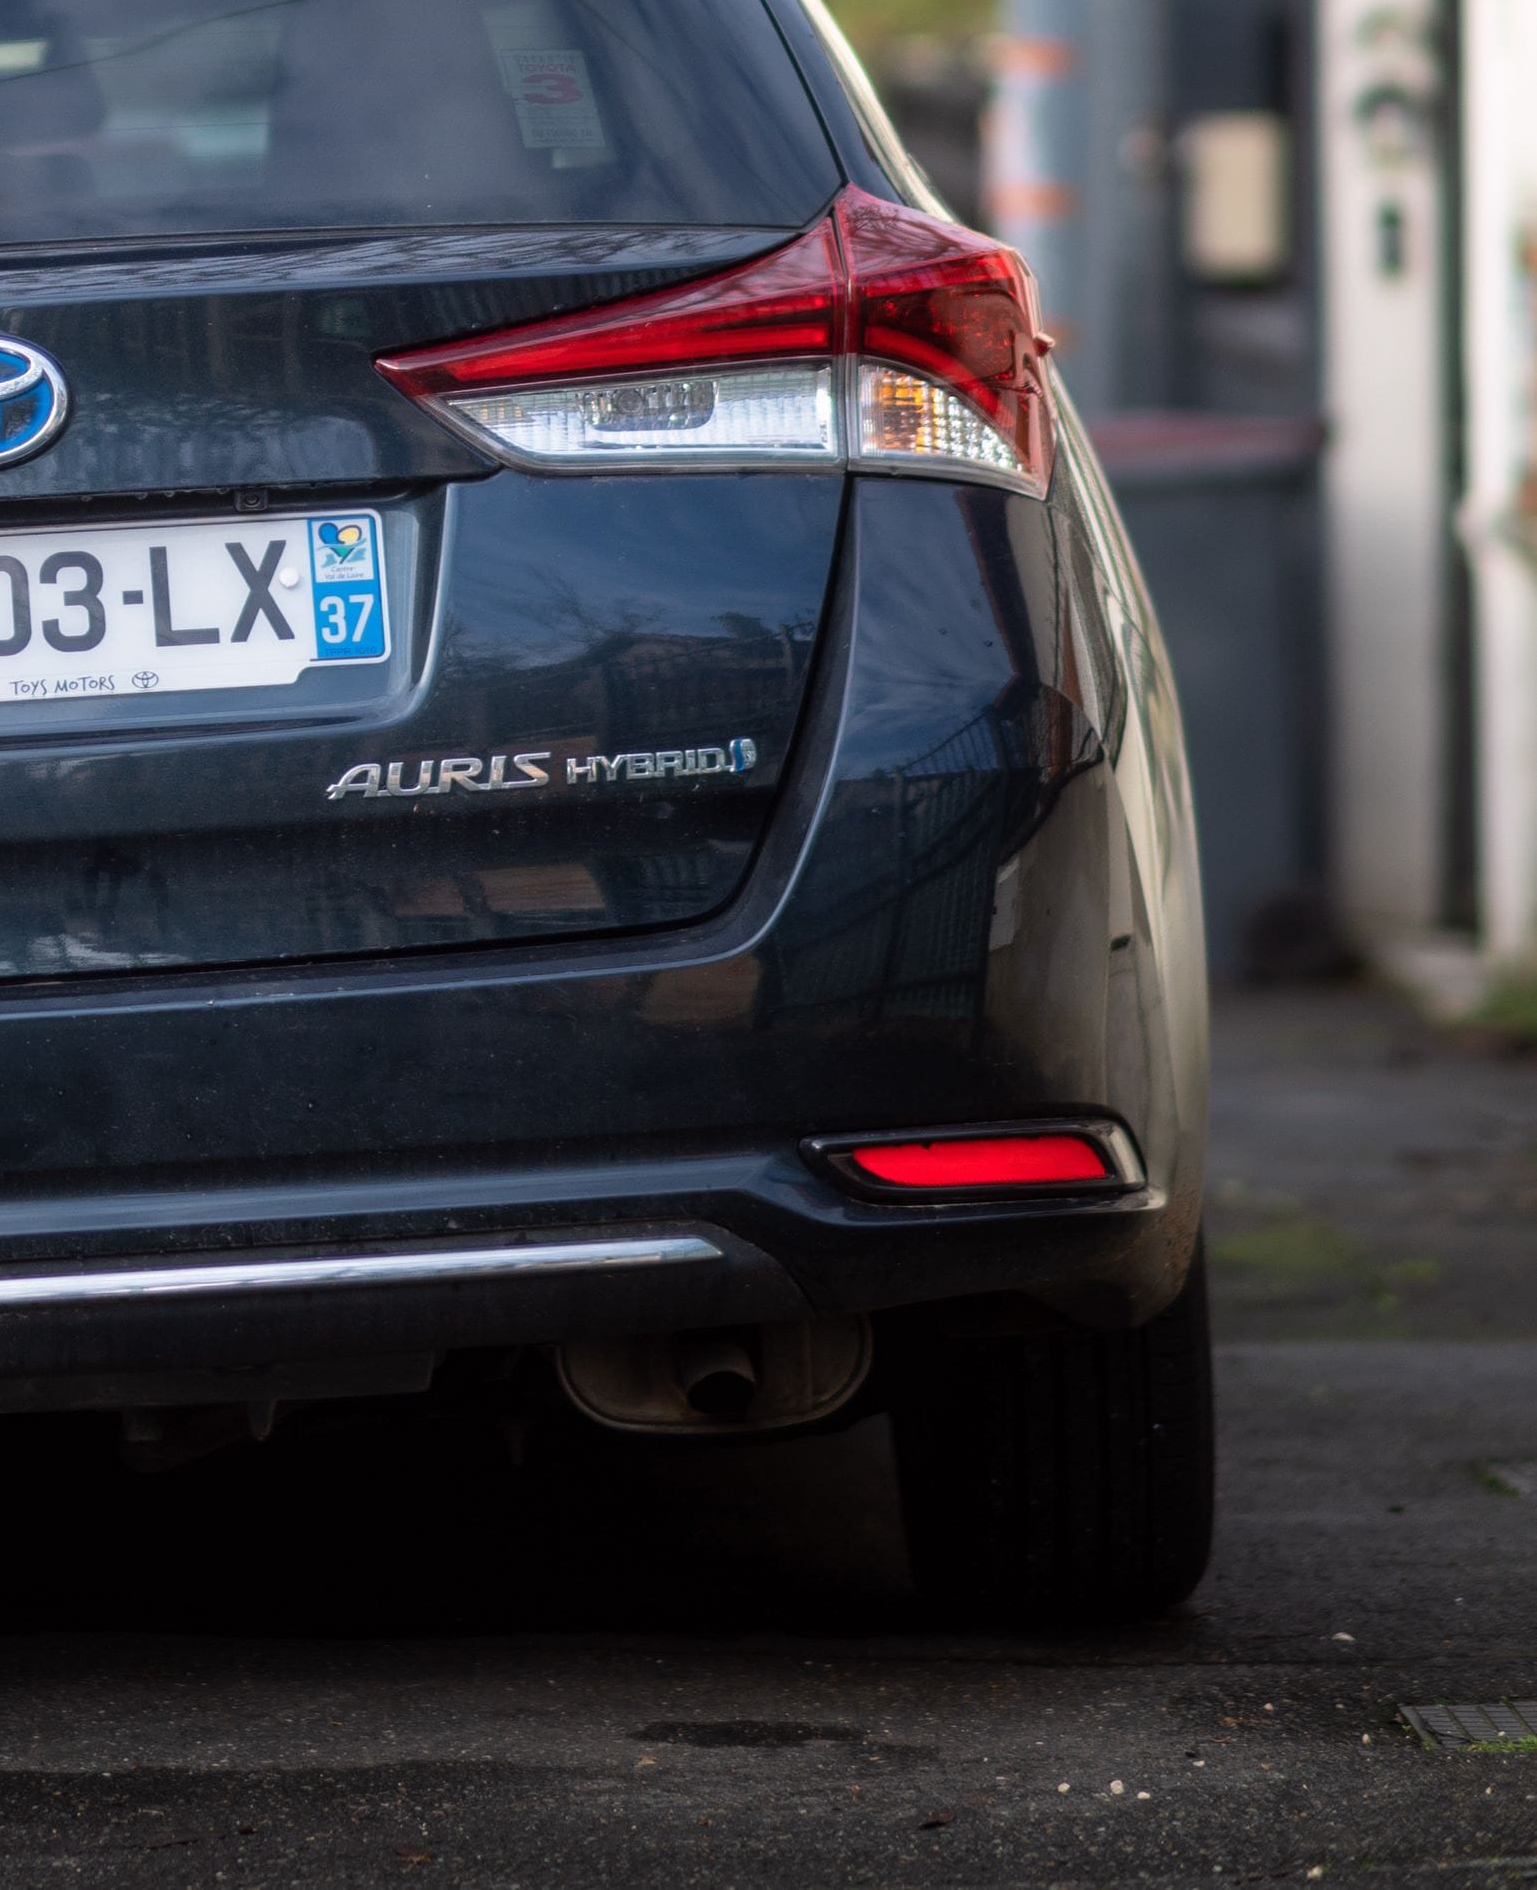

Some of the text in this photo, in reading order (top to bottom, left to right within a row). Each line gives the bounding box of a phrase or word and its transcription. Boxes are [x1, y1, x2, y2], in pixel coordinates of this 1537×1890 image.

[519, 63, 576, 72] TOYOTA
[521, 74, 583, 104] 3
[319, 594, 374, 644] 37
[325, 747, 730, 800] AURIS HYBRID
